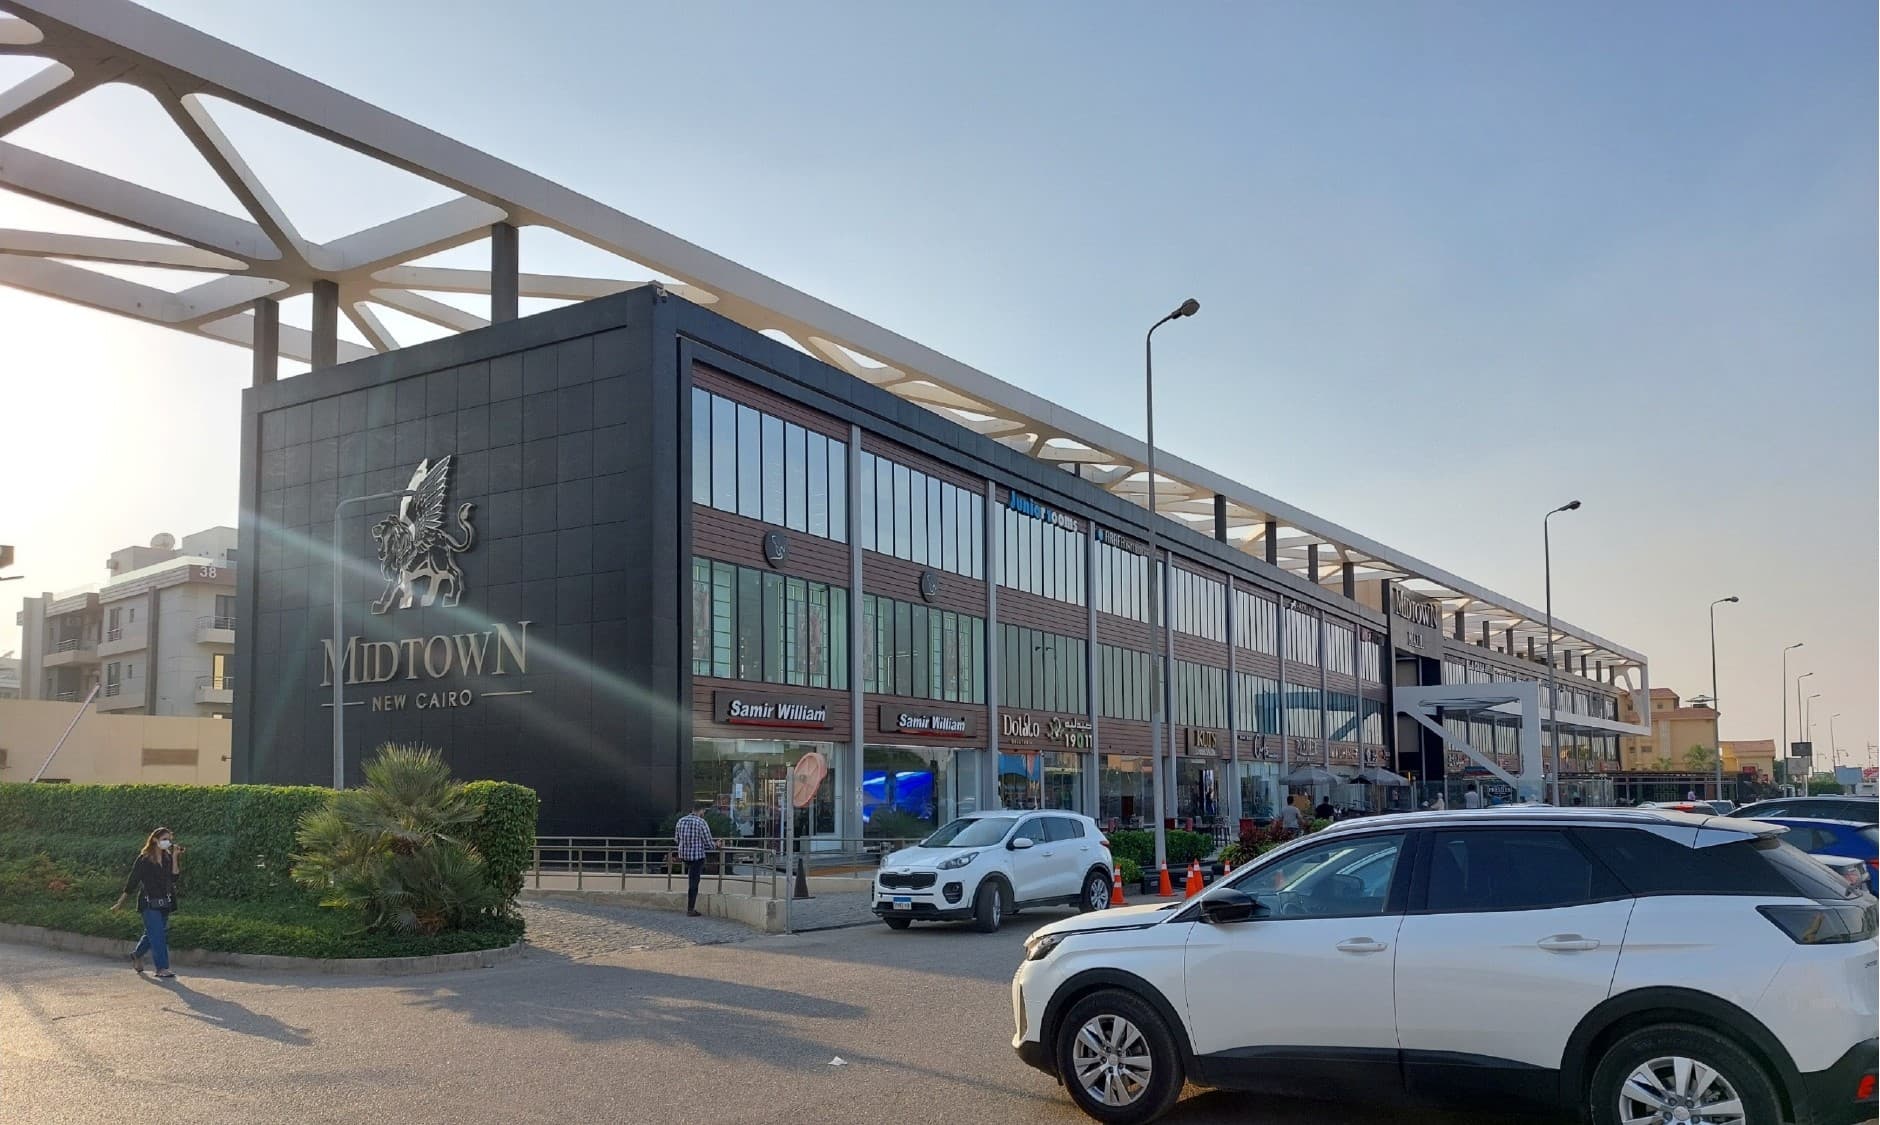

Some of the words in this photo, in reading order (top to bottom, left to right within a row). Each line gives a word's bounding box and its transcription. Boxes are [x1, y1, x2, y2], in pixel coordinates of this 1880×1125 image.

[199, 566, 217, 578] 38
[319, 620, 533, 687] MIDTOWN
[371, 695, 407, 712] NEW
[415, 689, 473, 709] CAIRO
[730, 699, 774, 718] Samir
[777, 703, 826, 721] William
[899, 713, 930, 729] Samir
[931, 715, 966, 732] William
[1064, 732, 1093, 749] 19011
